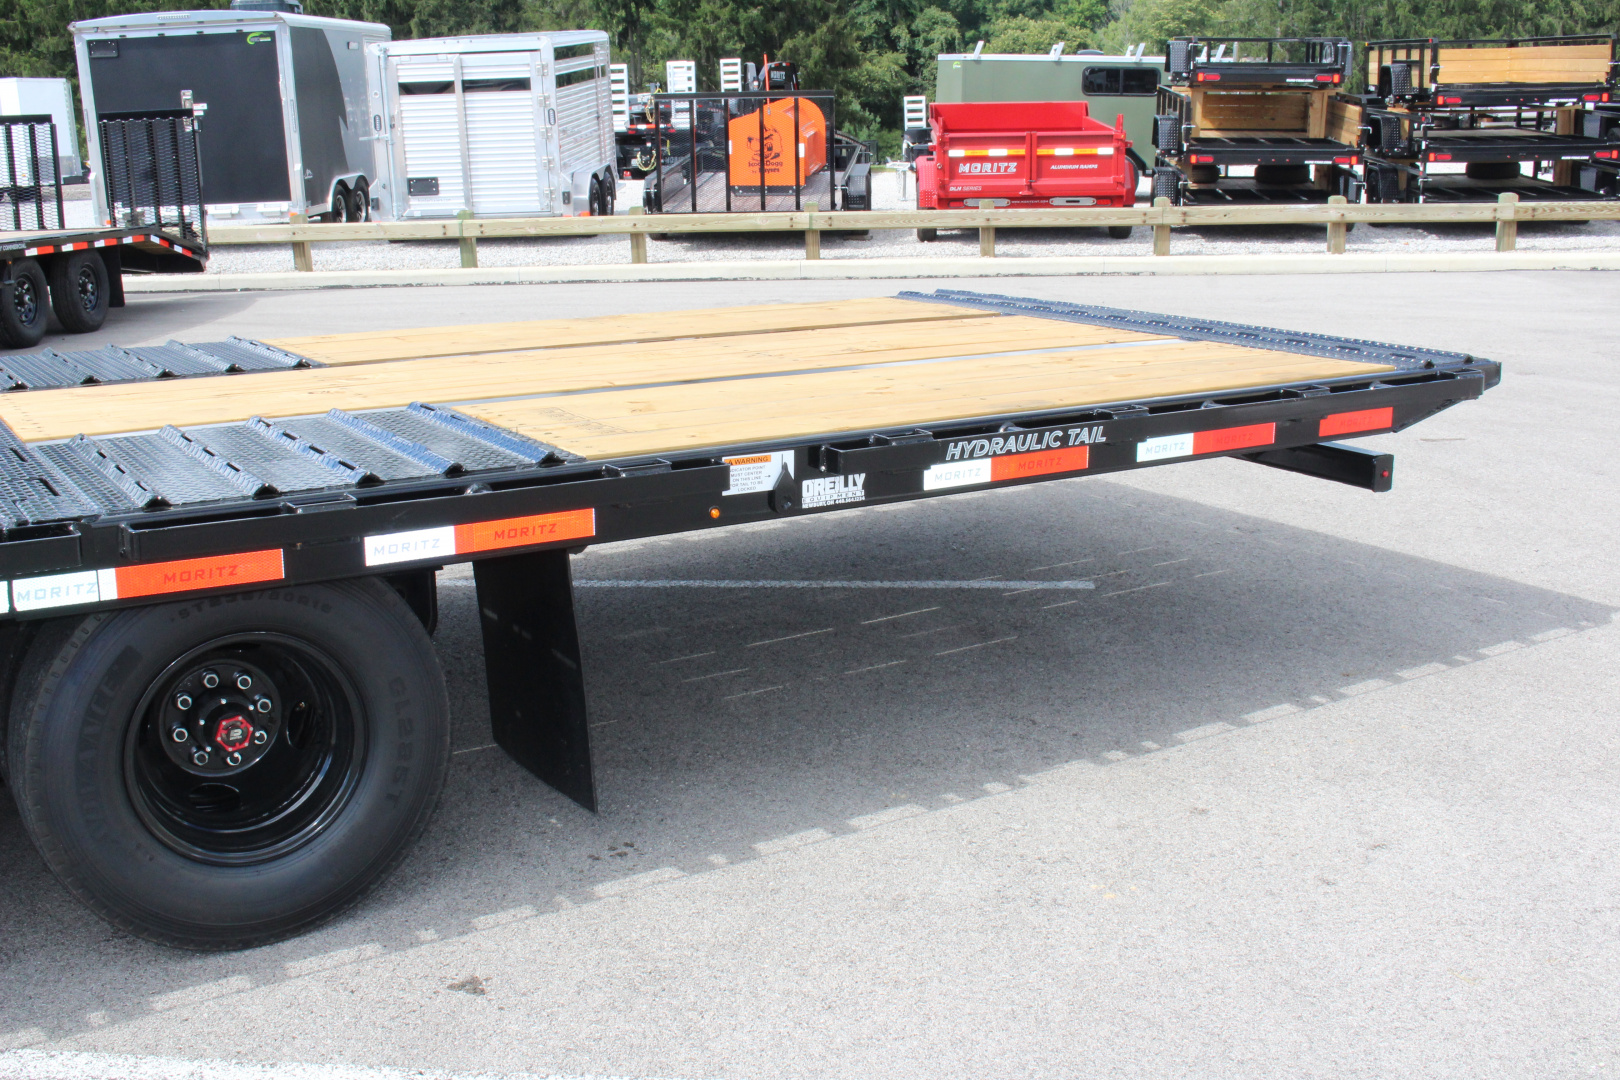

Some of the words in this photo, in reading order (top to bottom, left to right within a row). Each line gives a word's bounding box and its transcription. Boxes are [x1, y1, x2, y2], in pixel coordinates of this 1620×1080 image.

[958, 162, 1018, 173] MORITZ
[945, 430, 1063, 461] HYDRAULIC
[1067, 426, 1107, 446] TAIL
[1216, 432, 1254, 444] MORITZ
[1145, 441, 1185, 455] MORITZ
[735, 456, 768, 465] WARNING
[1018, 456, 1063, 472] MORITZ
[934, 467, 982, 483] MORITZ
[802, 490, 864, 503] EQUIPMENT
[494, 523, 558, 540] MORITZ
[374, 538, 441, 557] MORITZ
[164, 565, 239, 585] MORITZ
[17, 581, 98, 601] MORITZ
